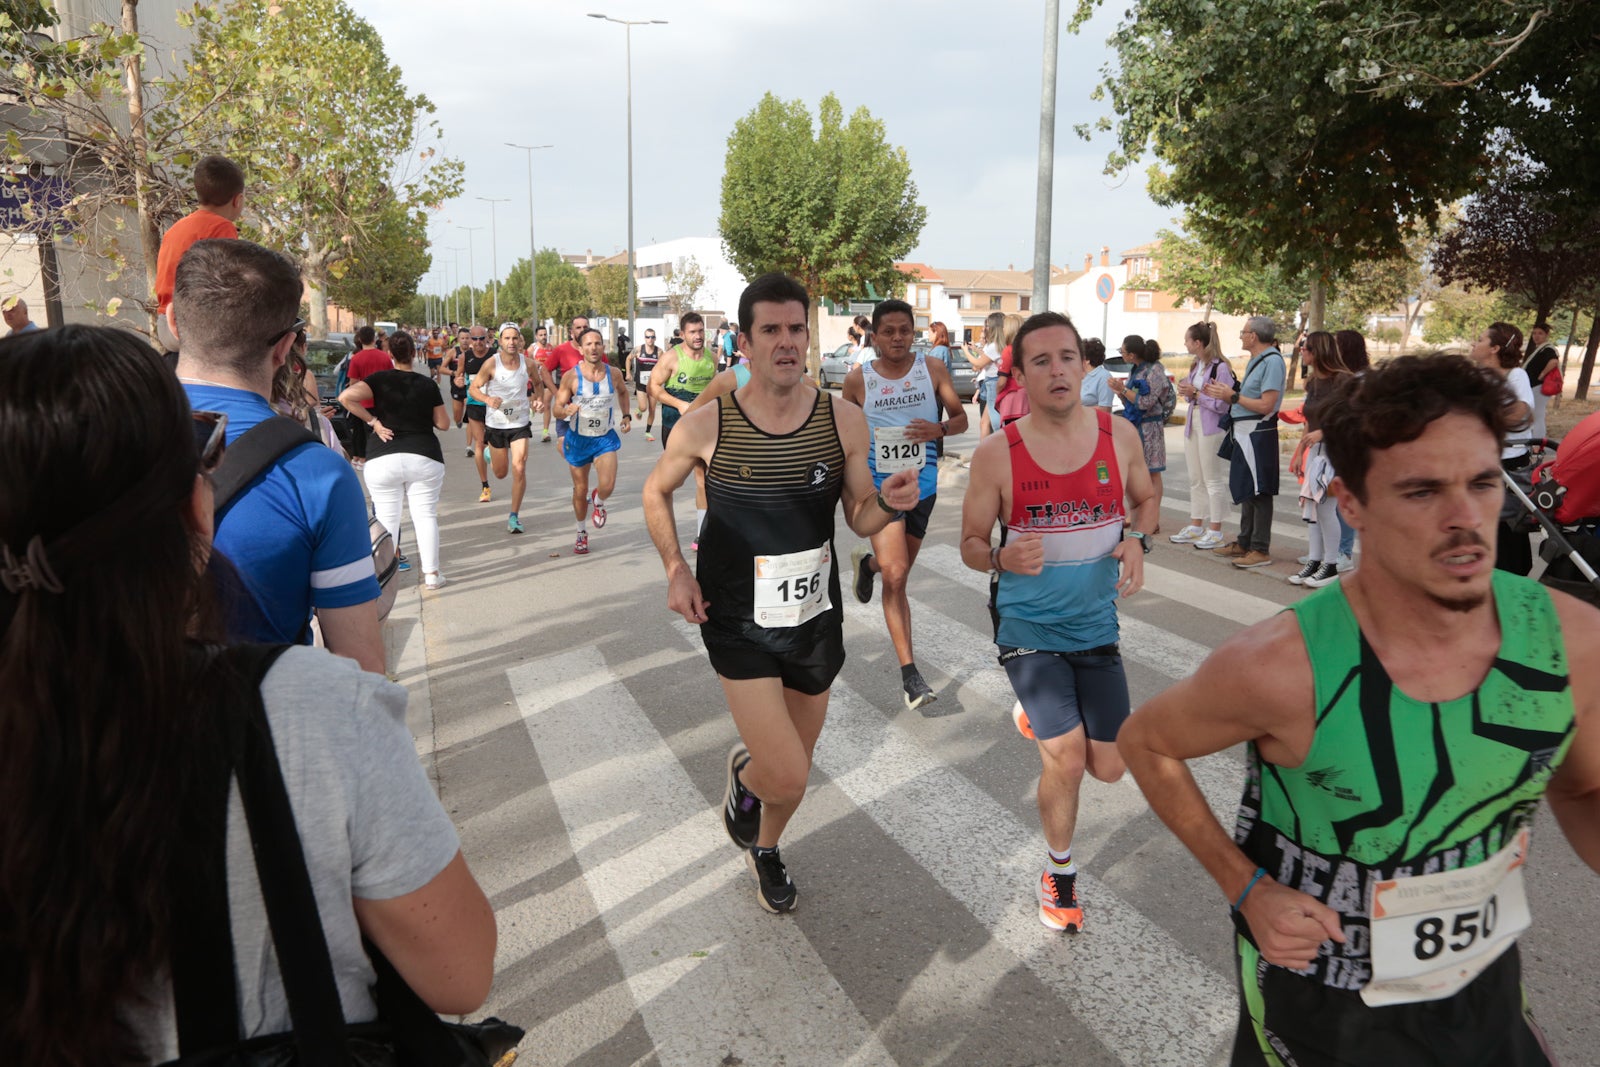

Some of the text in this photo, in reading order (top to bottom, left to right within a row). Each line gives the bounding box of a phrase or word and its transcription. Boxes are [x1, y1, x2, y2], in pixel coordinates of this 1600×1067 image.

[874, 392, 926, 408] MARACENA
[503, 408, 514, 416] 87
[588, 419, 601, 427] 29
[881, 443, 920, 459] 3120
[777, 572, 821, 602] 156
[1414, 894, 1498, 961] 850
